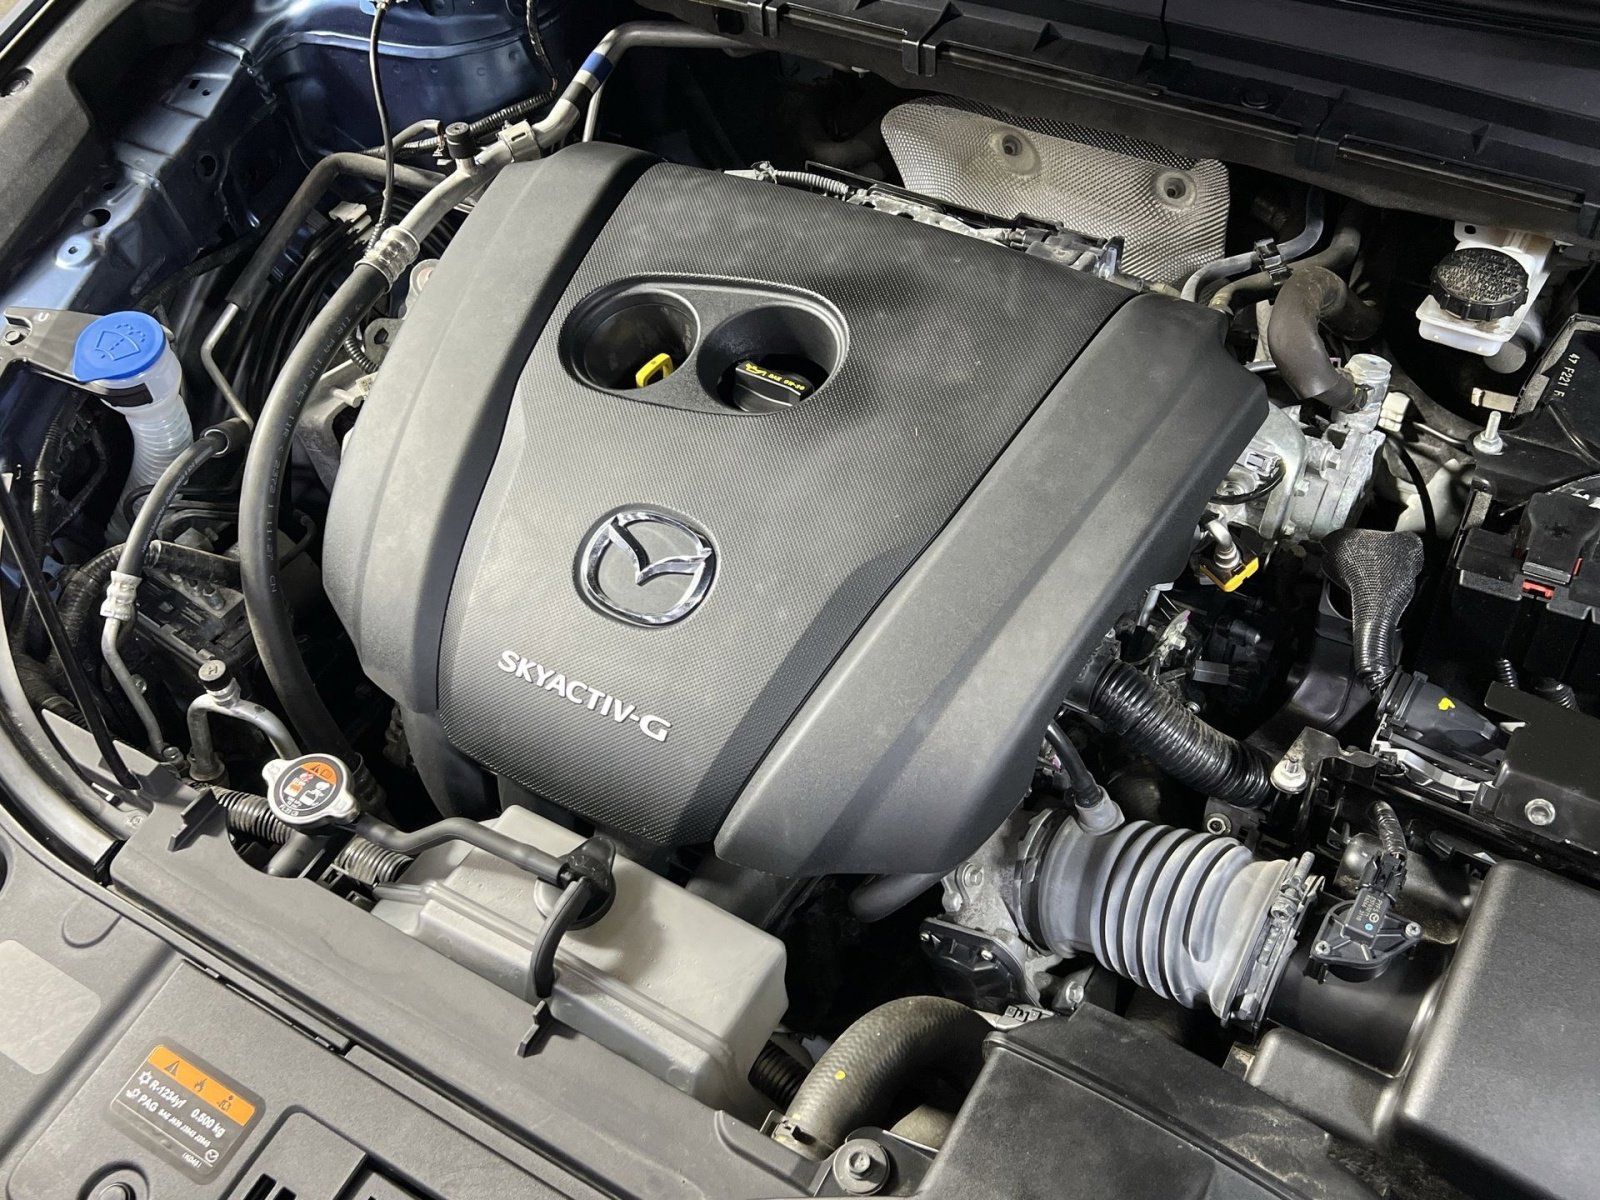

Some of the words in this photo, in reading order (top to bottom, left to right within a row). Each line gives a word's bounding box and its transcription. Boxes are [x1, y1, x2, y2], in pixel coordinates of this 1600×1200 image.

[1568, 353, 1580, 364] 47
[1558, 366, 1575, 386] F221
[498, 650, 672, 742] SKYACTIV-G
[138, 1094, 158, 1112] PAG
[191, 1108, 215, 1128] 0.500
[211, 1119, 226, 1138] kg
